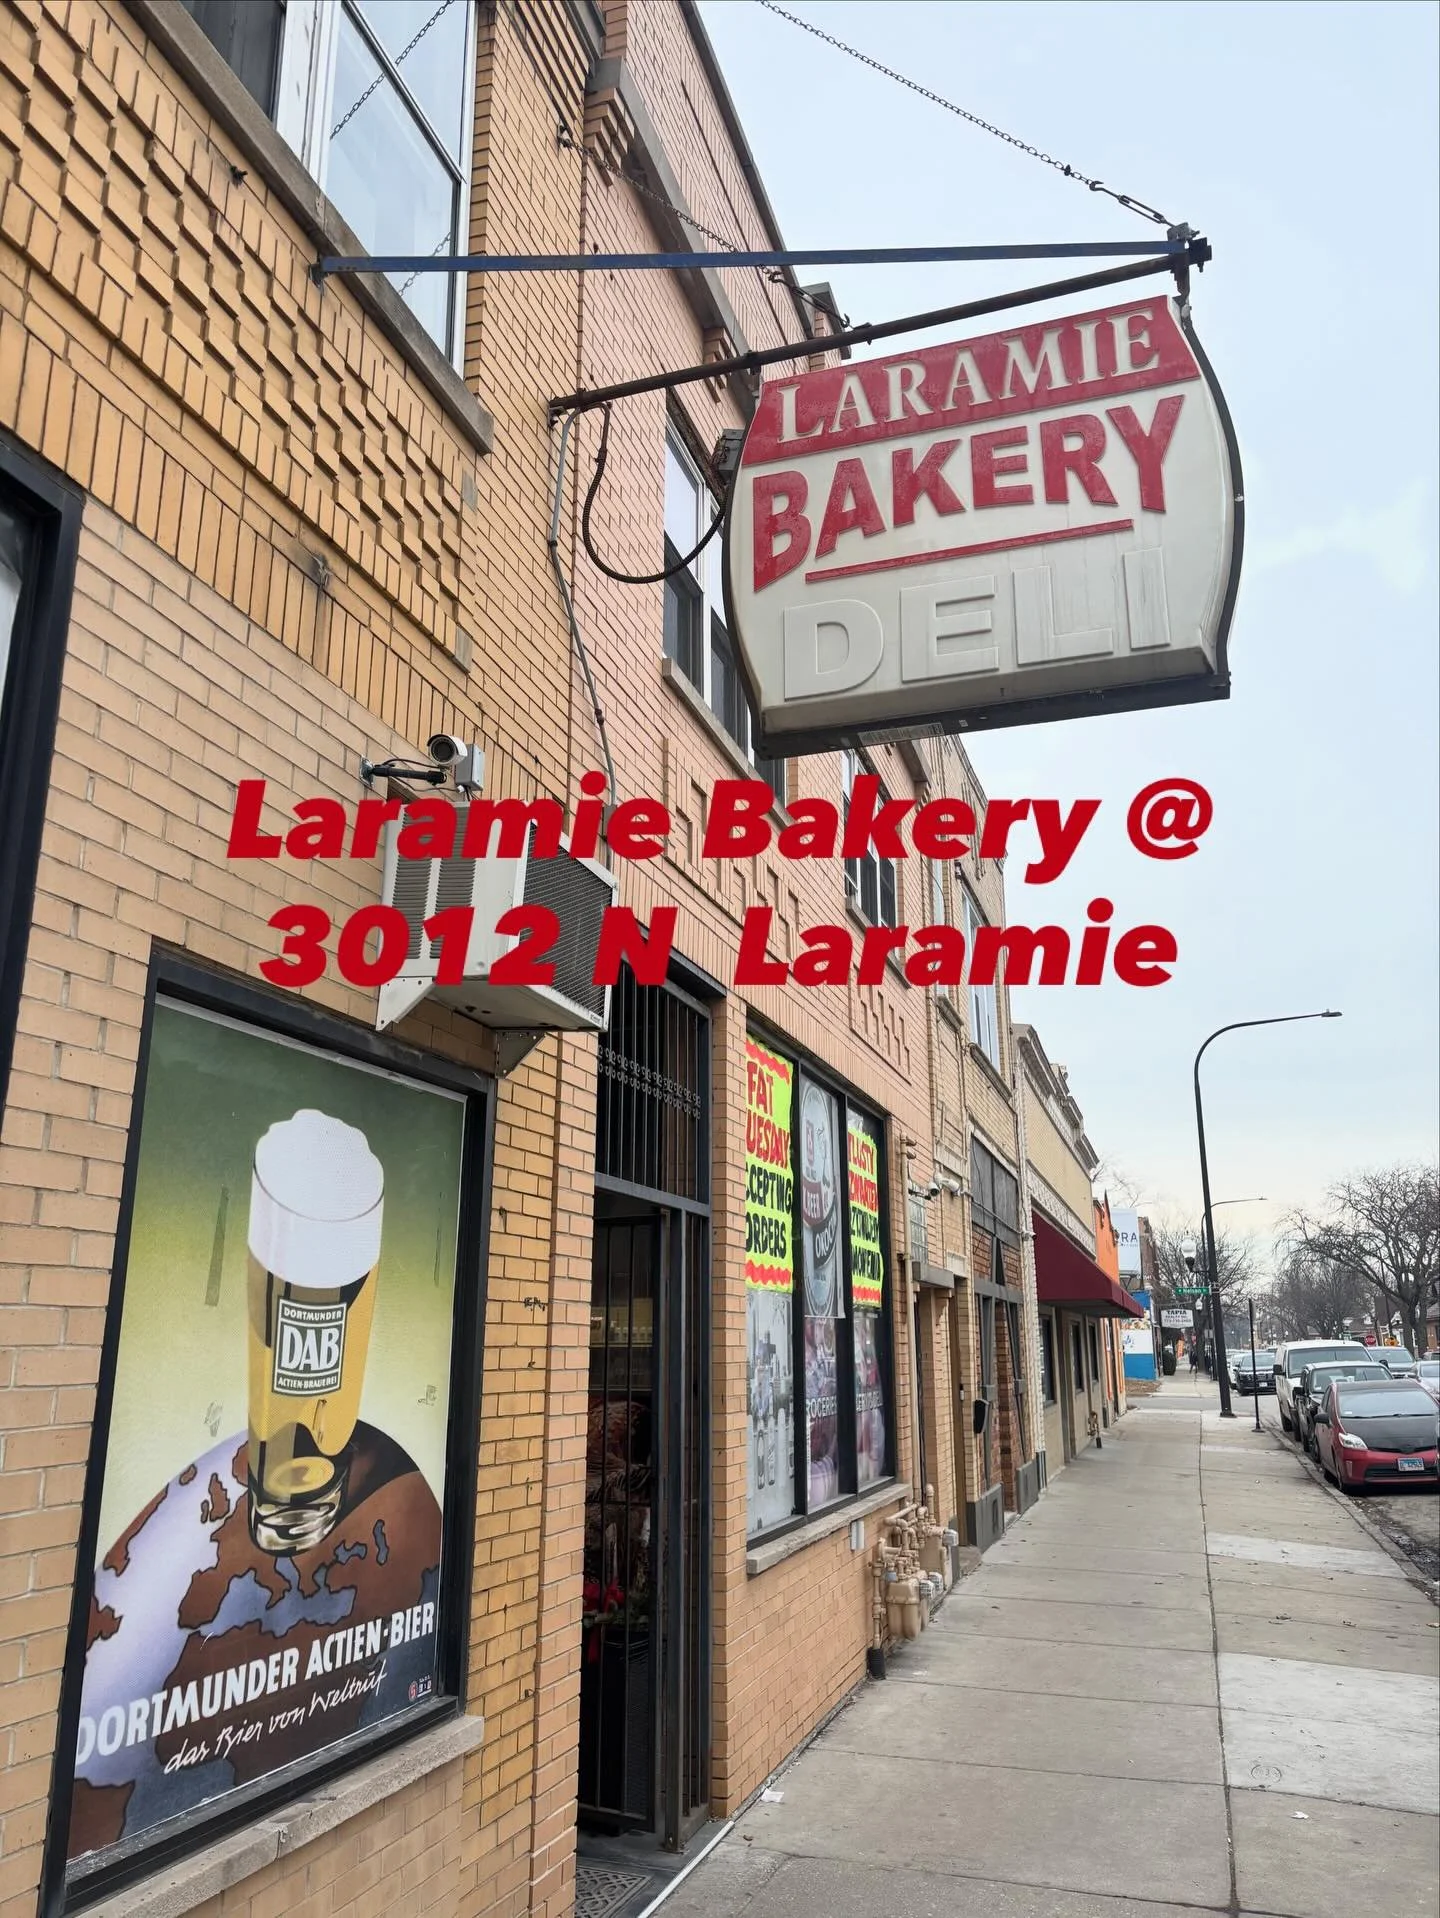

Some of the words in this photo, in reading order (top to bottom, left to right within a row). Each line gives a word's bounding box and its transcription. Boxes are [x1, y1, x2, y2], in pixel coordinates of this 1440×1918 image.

[776, 308, 1160, 444] LARAMIE
[752, 394, 1186, 593] BAKERY
[783, 547, 1171, 702] DELI
[746, 1060, 774, 1116] FAT
[746, 1109, 790, 1170] UESDAY
[746, 1161, 793, 1215] CEPTING
[1121, 1231, 1138, 1243] RA
[283, 1306, 342, 1321] DORTMUNDER
[280, 1324, 340, 1372] DAB
[277, 1375, 338, 1390] ACTIEN-BRAUEREI
[75, 1647, 300, 1766] DORTMUNDER
[305, 1601, 435, 1681] ACTIEN-BIER
[163, 1738, 210, 1775] das
[214, 1719, 262, 1759] Bier
[268, 1707, 306, 1734] von
